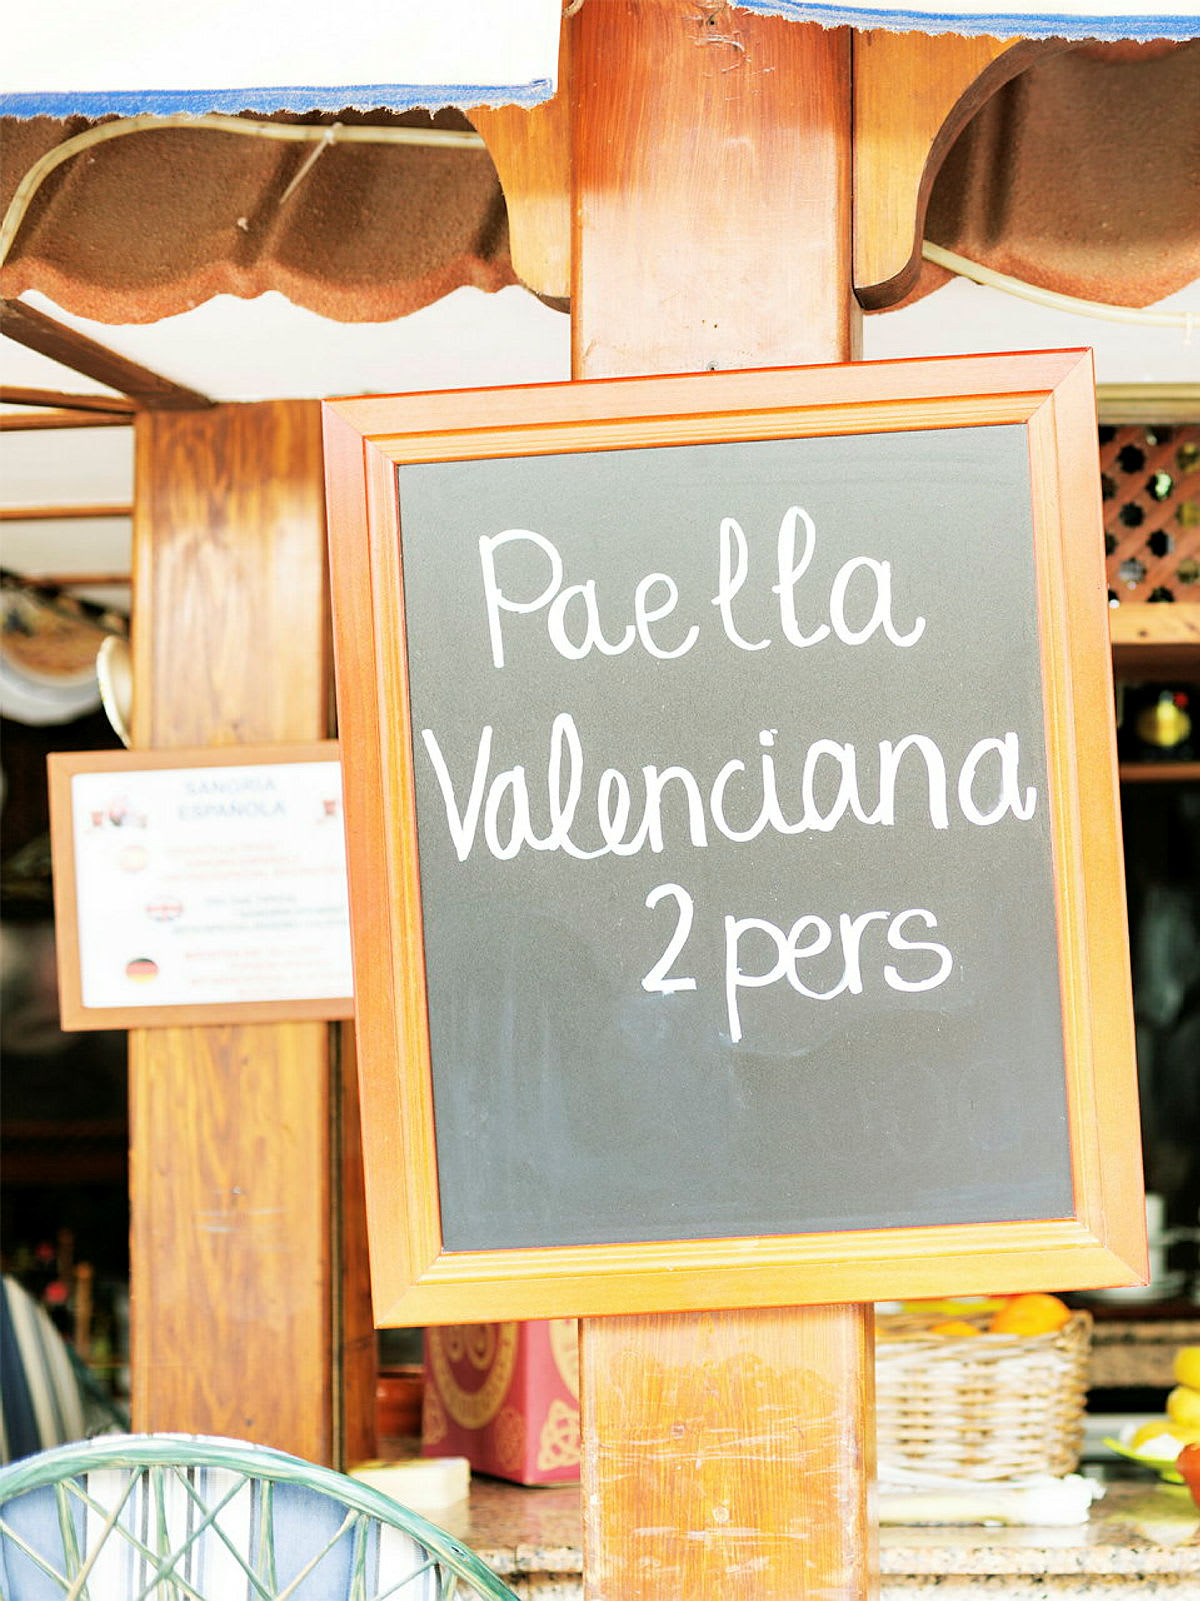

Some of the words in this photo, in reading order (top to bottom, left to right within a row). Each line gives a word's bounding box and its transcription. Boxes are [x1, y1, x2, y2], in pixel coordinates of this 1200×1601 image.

[479, 506, 926, 669] Paella
[421, 712, 1038, 862] Valenciana
[641, 883, 697, 994] 2
[724, 909, 954, 1043] pers
